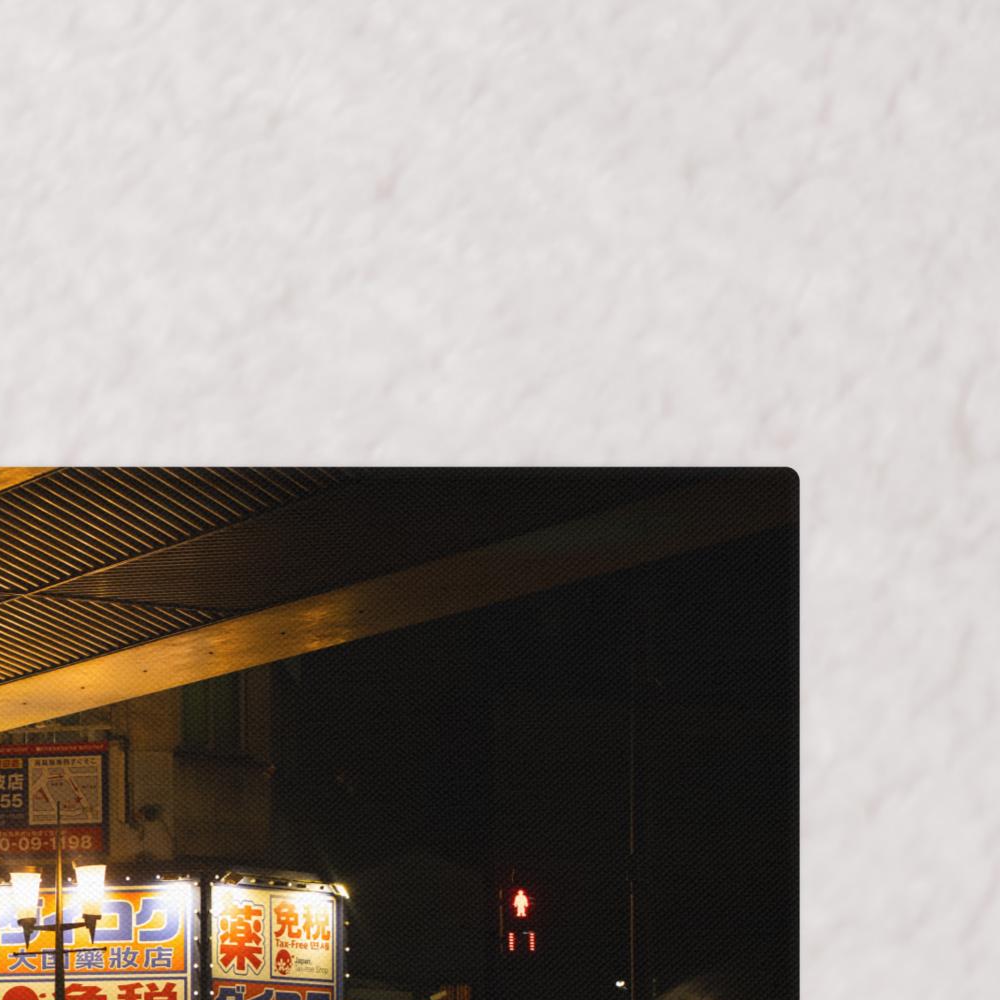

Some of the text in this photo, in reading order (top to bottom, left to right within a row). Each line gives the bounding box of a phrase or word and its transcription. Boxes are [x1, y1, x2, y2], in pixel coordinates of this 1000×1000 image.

[220, 904, 263, 971] 薬
[274, 900, 331, 942] 免税
[275, 939, 308, 950] Tax-Free
